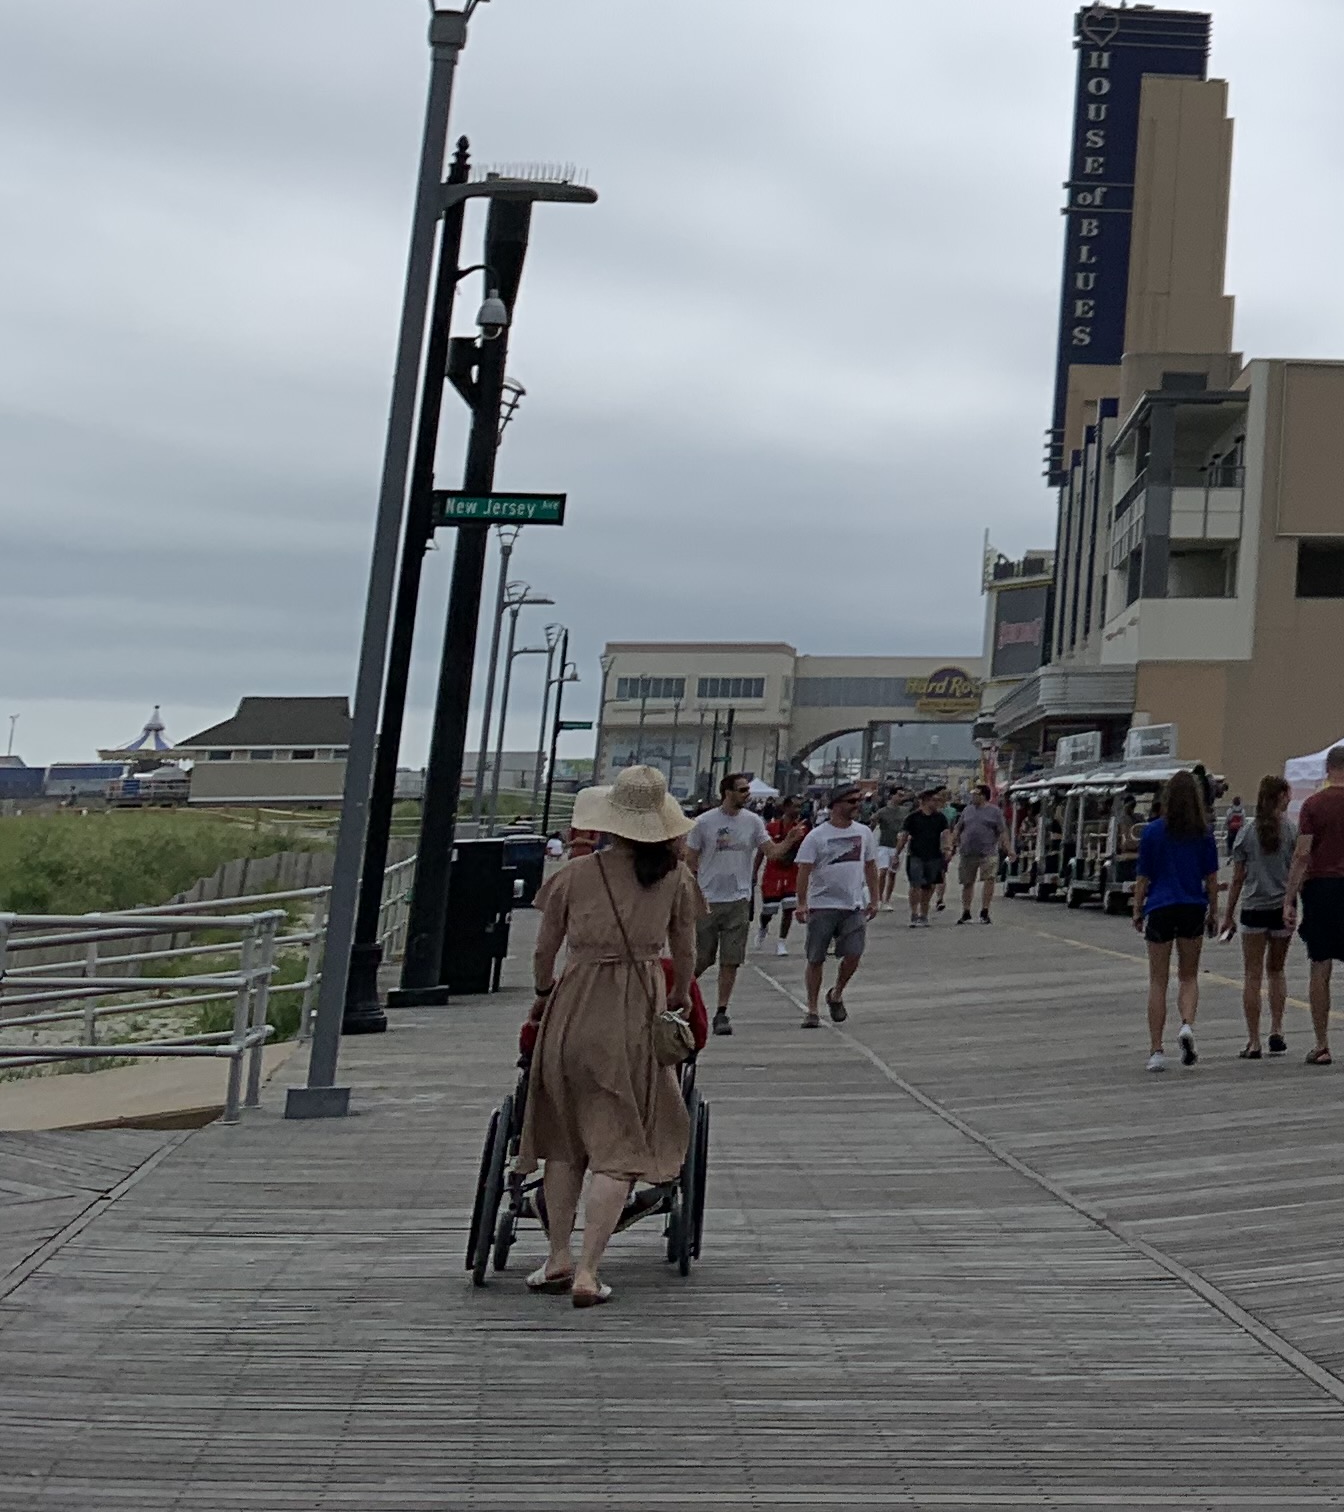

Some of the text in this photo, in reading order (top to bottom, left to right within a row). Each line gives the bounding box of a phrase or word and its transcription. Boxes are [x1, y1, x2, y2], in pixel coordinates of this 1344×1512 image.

[1071, 50, 1112, 347] HOUSE of BLUES
[445, 498, 478, 514] New
[483, 499, 536, 518] Jersey
